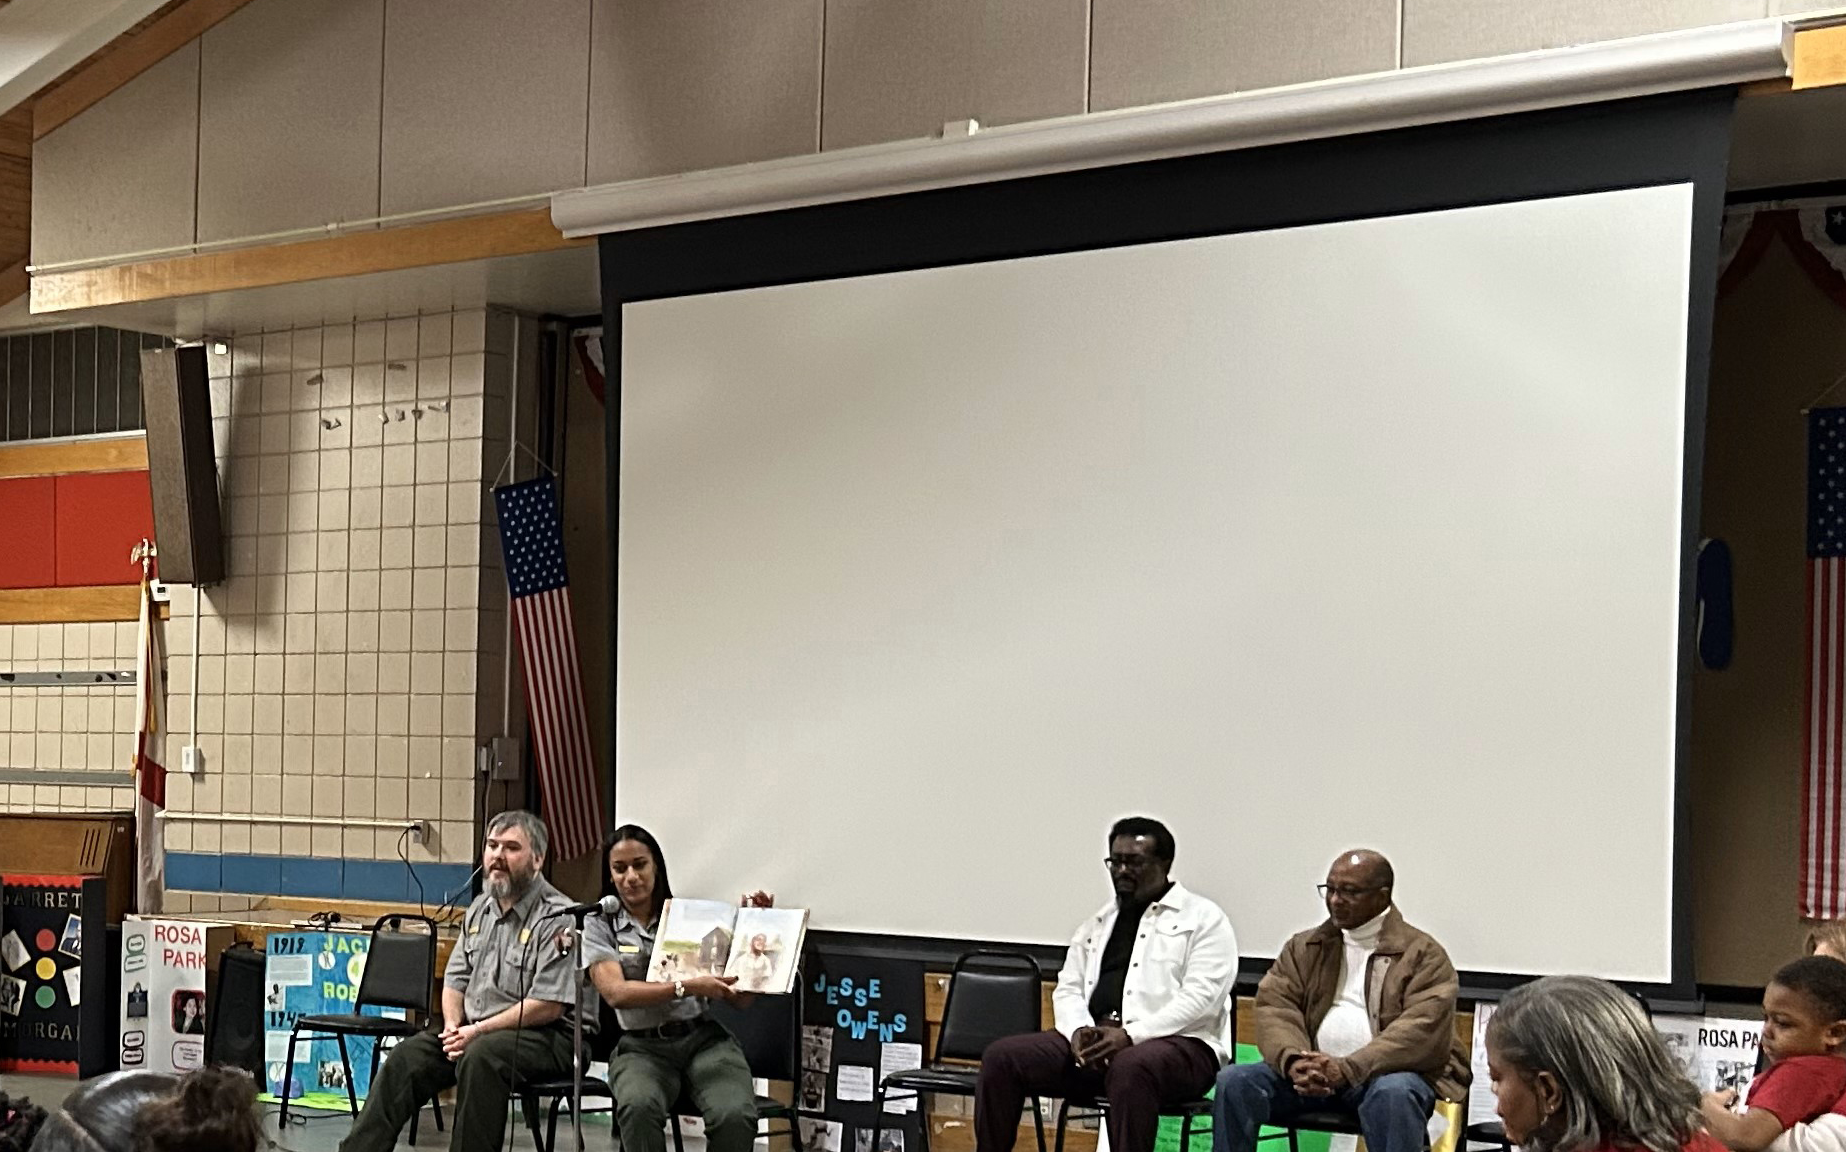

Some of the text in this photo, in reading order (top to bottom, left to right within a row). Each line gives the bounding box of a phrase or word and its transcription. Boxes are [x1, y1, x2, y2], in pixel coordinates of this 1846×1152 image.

[155, 925, 202, 945] ROSA
[274, 937, 306, 954] 1919
[163, 948, 206, 969] PARK
[323, 981, 360, 1003] ROB
[814, 974, 881, 1007] JESSE
[4, 1021, 80, 1041] MORGA
[837, 1009, 907, 1042] OWENS
[1698, 1028, 1760, 1050] ROSA PA
